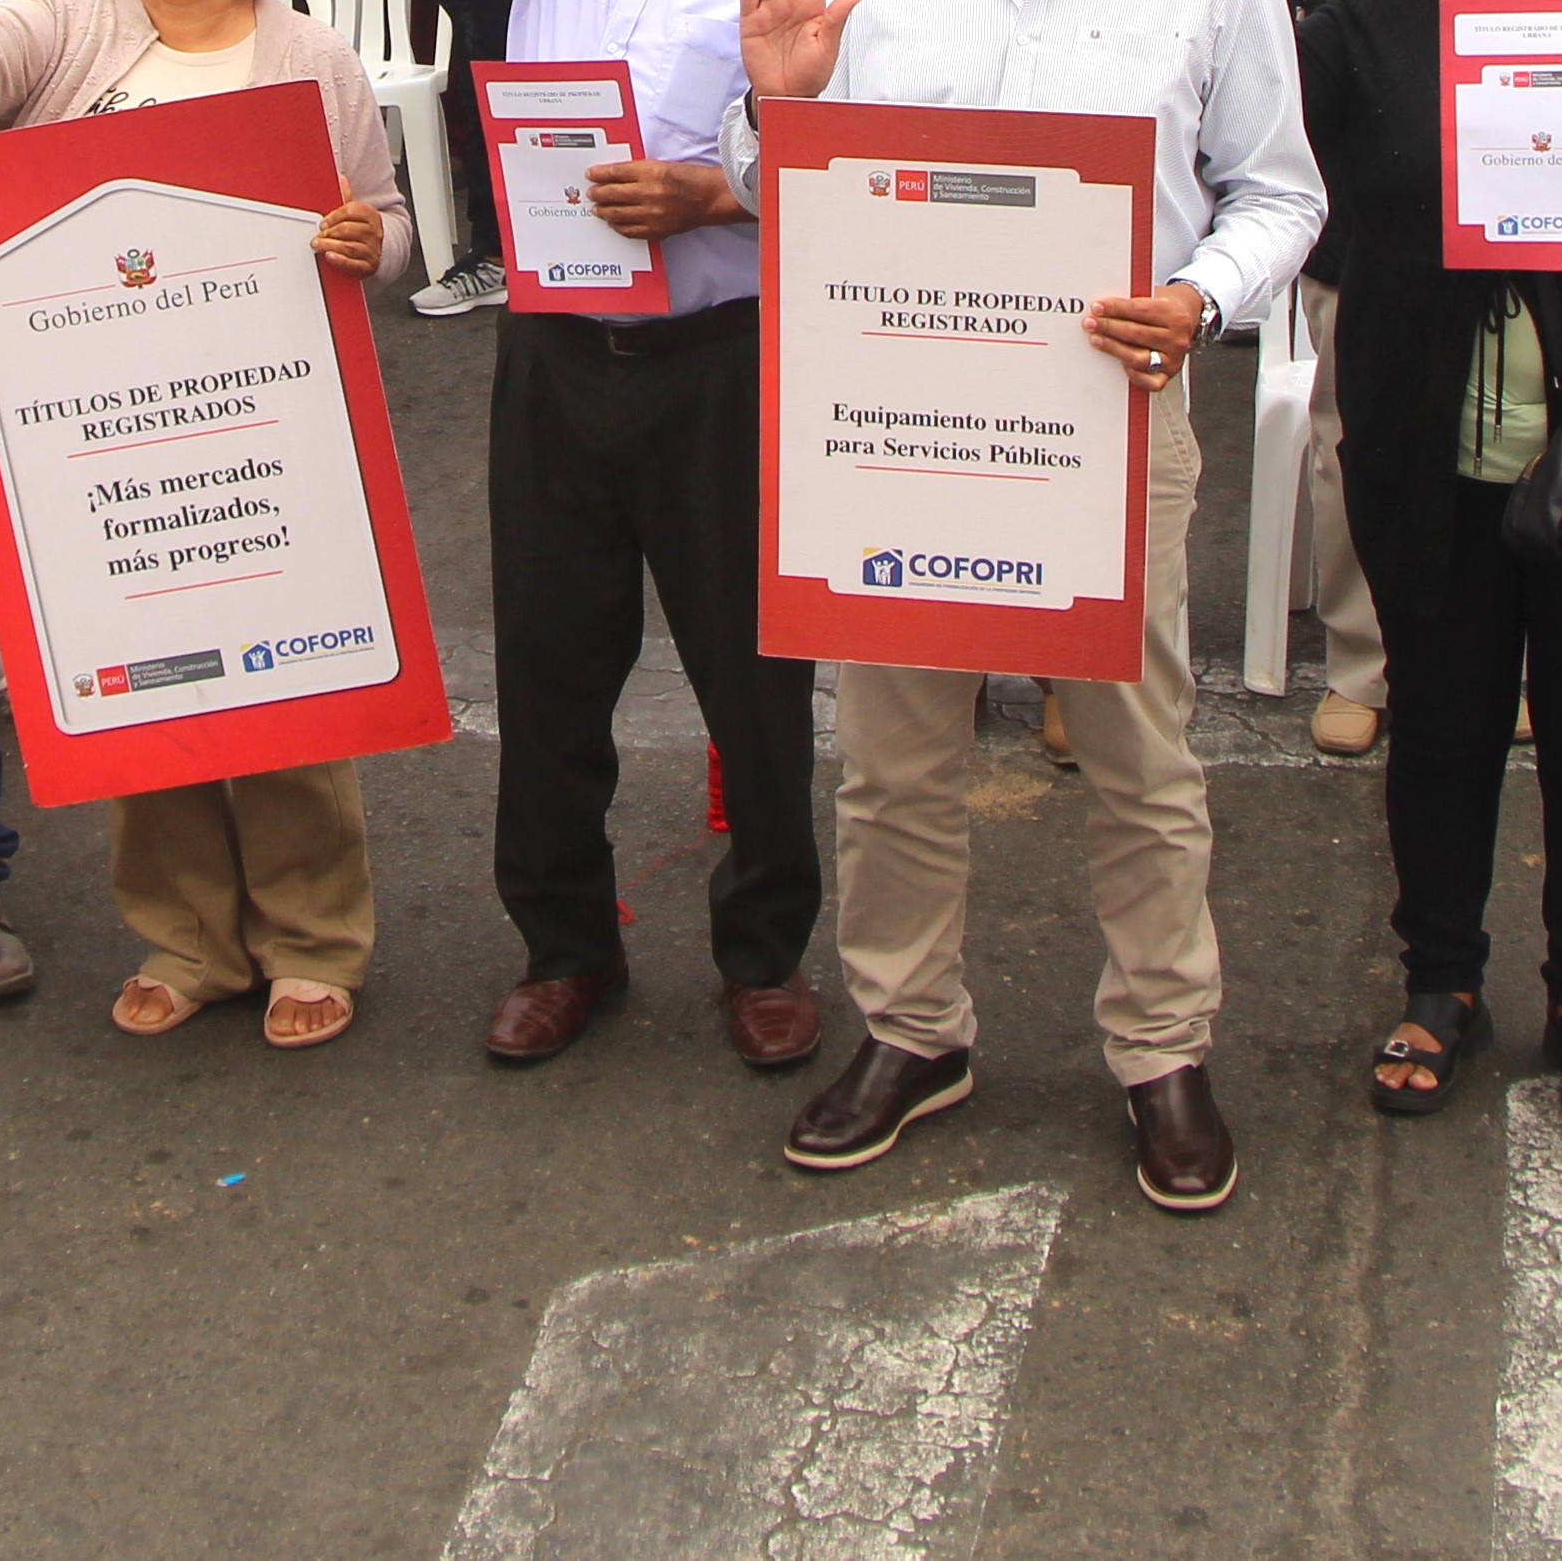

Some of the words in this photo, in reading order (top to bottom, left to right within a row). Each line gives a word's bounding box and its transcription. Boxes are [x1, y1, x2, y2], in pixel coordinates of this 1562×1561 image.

[1481, 153, 1543, 167] Gobierno
[899, 180, 925, 190] PERÚ
[933, 174, 972, 184] Ministerio
[945, 183, 978, 193] Vivienda,
[981, 185, 1031, 195] Construcción
[939, 191, 989, 201] Saneamiento
[529, 206, 578, 217] Gobierno
[580, 207, 593, 217] de
[567, 264, 622, 276] COFOPRI
[28, 293, 147, 334] Gobierno
[155, 288, 196, 313] del
[202, 273, 261, 307] Perú
[824, 280, 910, 307] TÍTULO
[916, 289, 947, 307] DE
[953, 291, 1085, 315] PROPIEDAD
[880, 310, 1028, 336] REGISTRADO
[14, 389, 123, 428] TÍTULOS
[127, 385, 163, 406] DE
[168, 358, 312, 400] PROPIEDAD
[81, 394, 257, 443] REGISTRADOS
[832, 402, 988, 434] Equipamiento
[994, 412, 1075, 437] urbano
[824, 438, 876, 458] para
[882, 438, 982, 464] Servicios
[989, 443, 1082, 470] Públicos
[86, 473, 153, 517] ¡Más
[158, 457, 284, 498] mercados
[102, 495, 281, 543] formalizados,
[107, 548, 159, 579] más
[168, 525, 292, 574] progreso!
[909, 554, 1042, 585] COFOPRI
[275, 625, 375, 657] COFOPRI
[101, 675, 125, 687] PERÚ
[130, 662, 165, 673] Ministerio
[131, 673, 141, 681] de
[174, 659, 219, 673] Construcción
